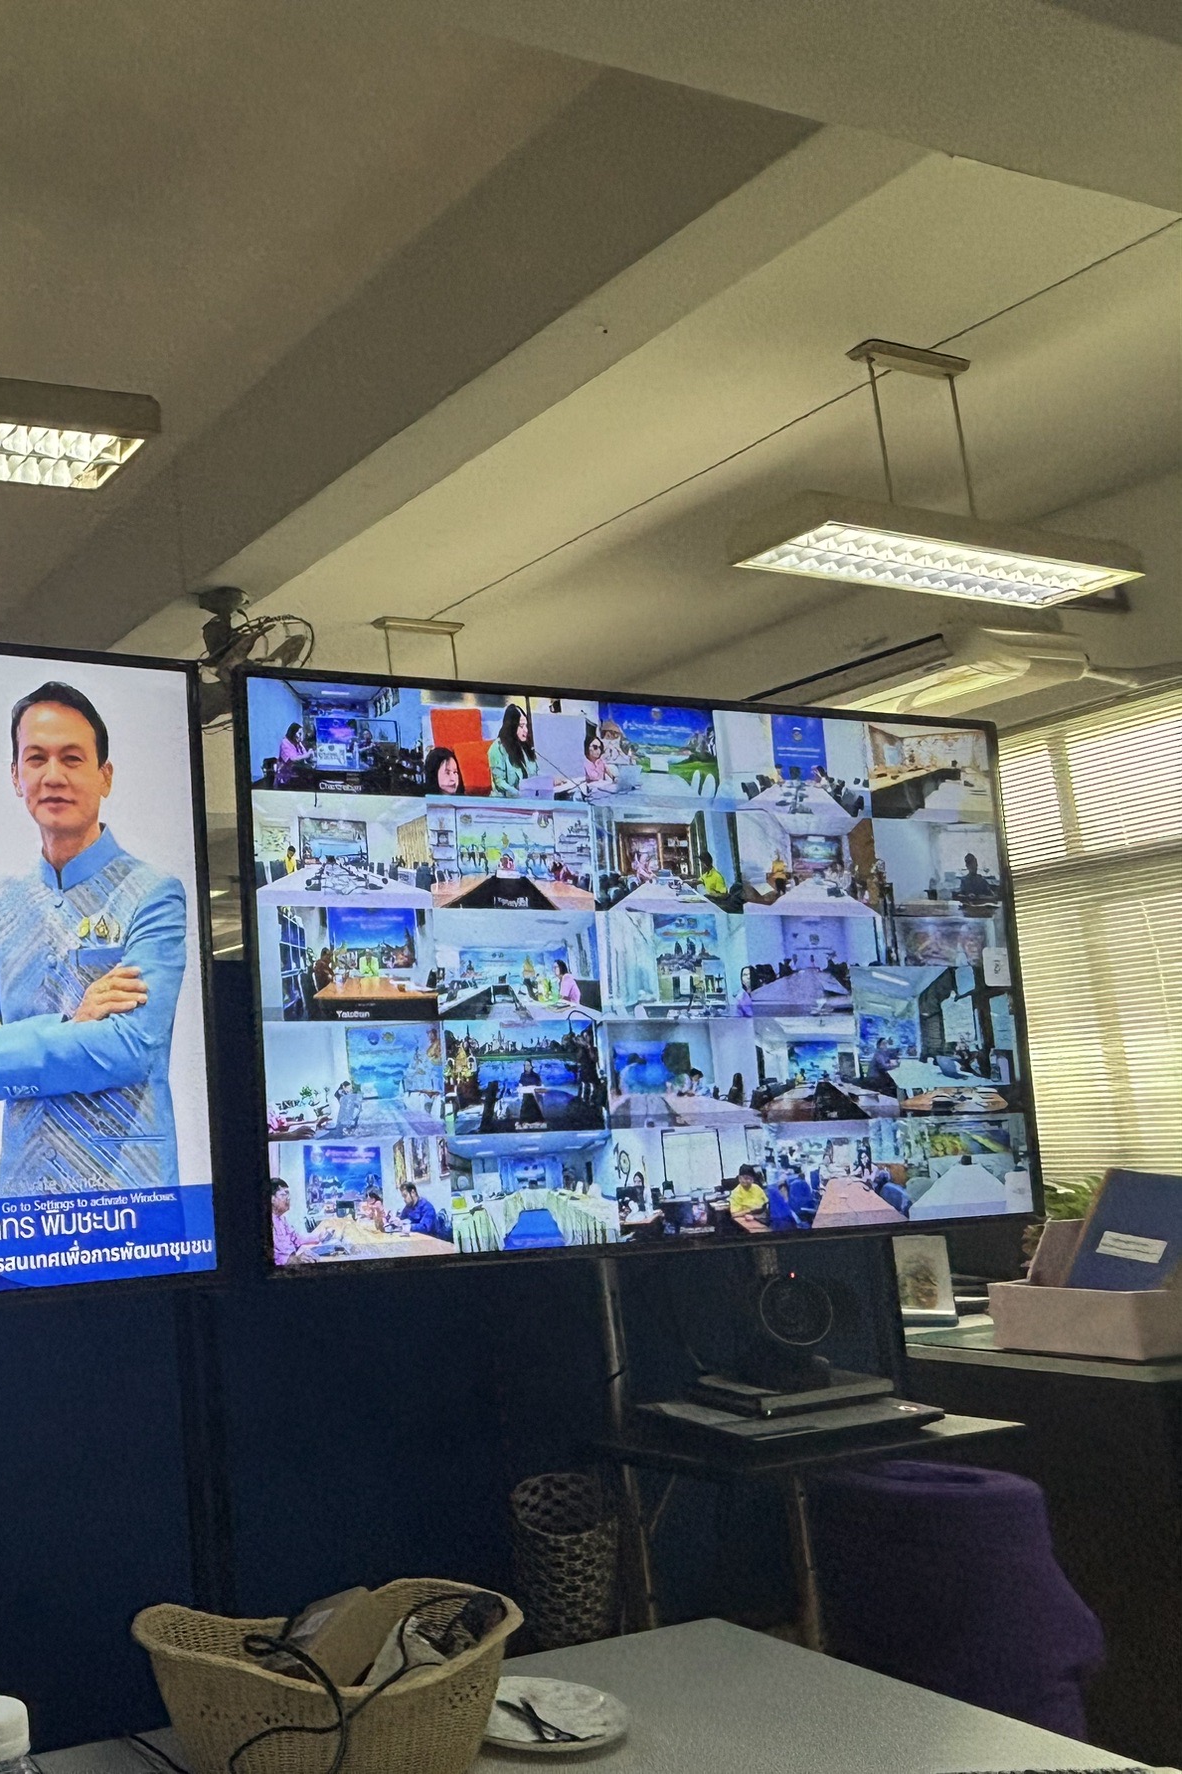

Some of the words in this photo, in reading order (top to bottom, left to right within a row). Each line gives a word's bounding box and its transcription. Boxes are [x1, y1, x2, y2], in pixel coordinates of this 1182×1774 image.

[2, 1203, 17, 1213] Go
[20, 1201, 31, 1212] to
[77, 1198, 88, 1207] to
